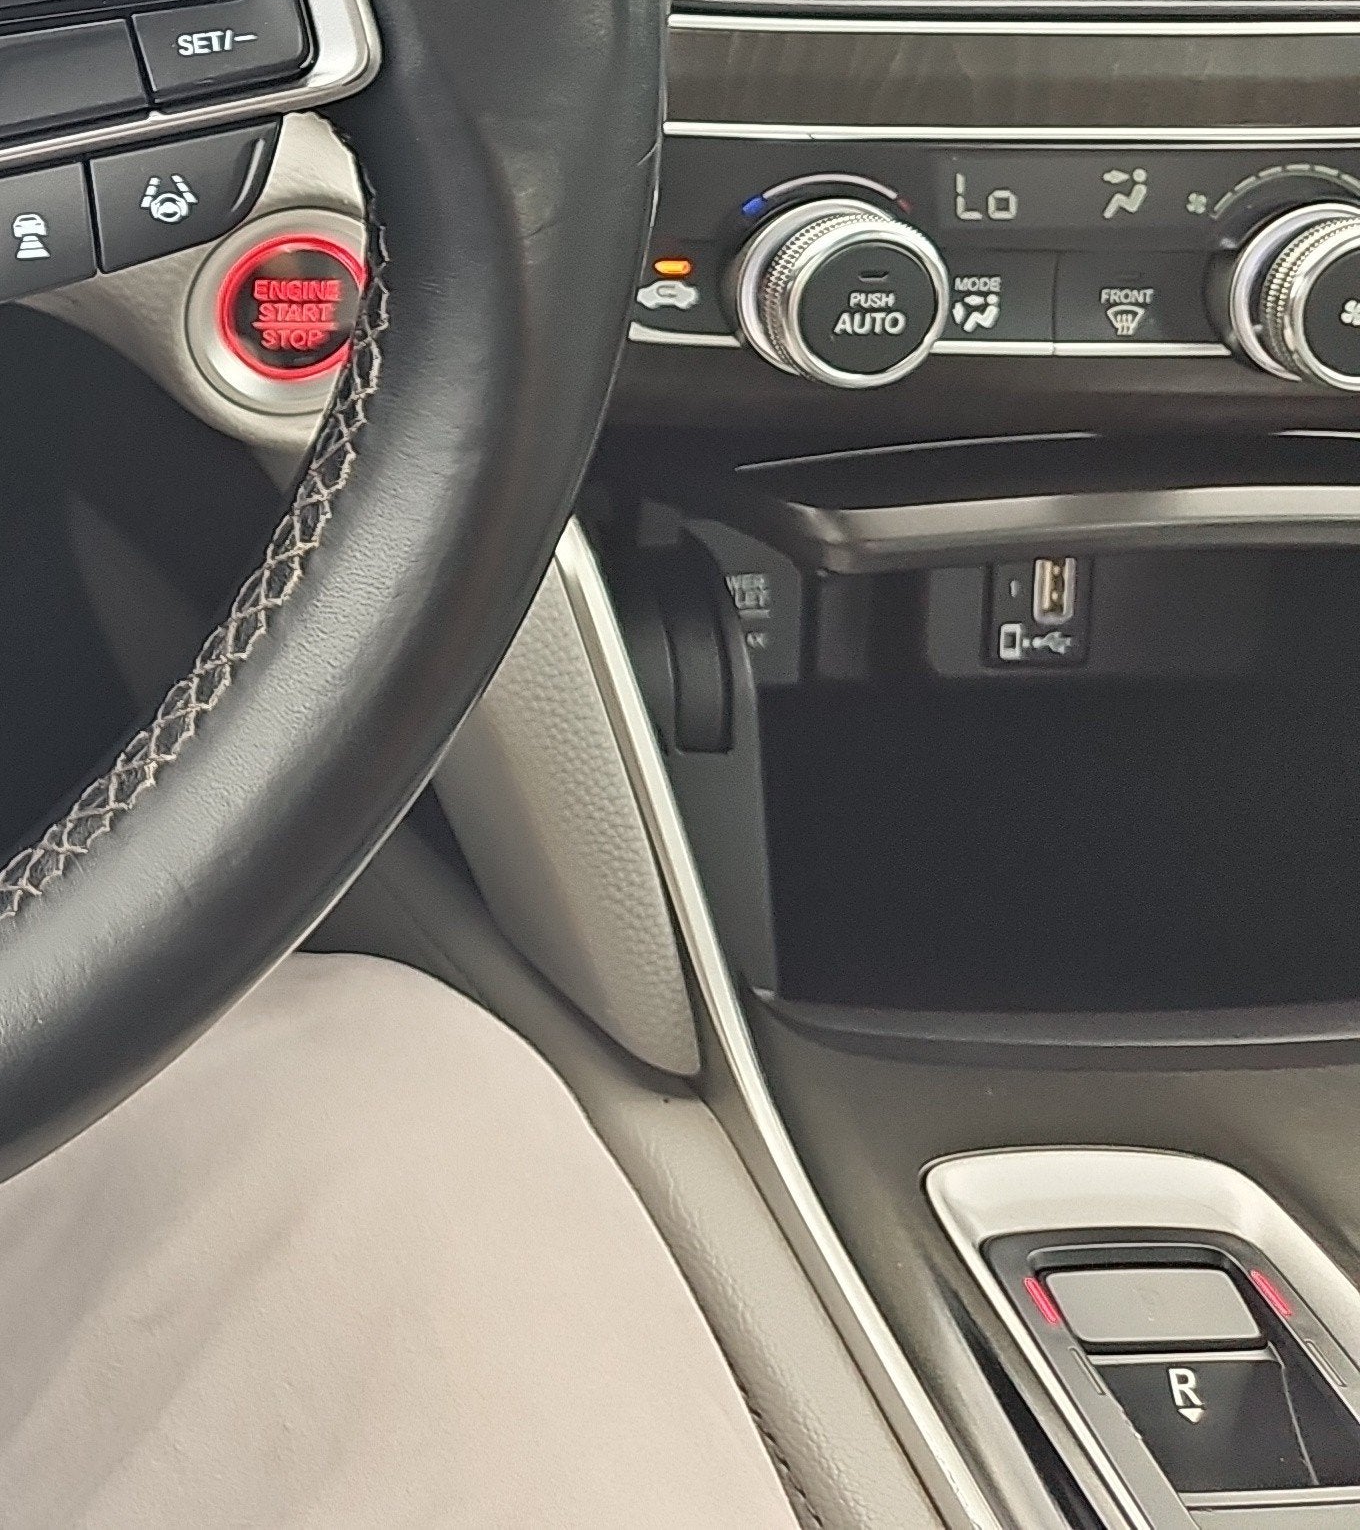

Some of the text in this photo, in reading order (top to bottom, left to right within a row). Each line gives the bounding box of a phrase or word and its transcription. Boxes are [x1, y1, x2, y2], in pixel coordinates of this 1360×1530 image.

[955, 172, 1018, 220] Lo
[252, 279, 343, 301] ENGINE
[954, 276, 1001, 293] MODE
[848, 291, 895, 310] PUSH
[1100, 288, 1154, 307] FRONT
[253, 301, 335, 323] START
[834, 310, 906, 337] AUTO
[260, 327, 329, 350] STOP
[1168, 1367, 1204, 1407] R
